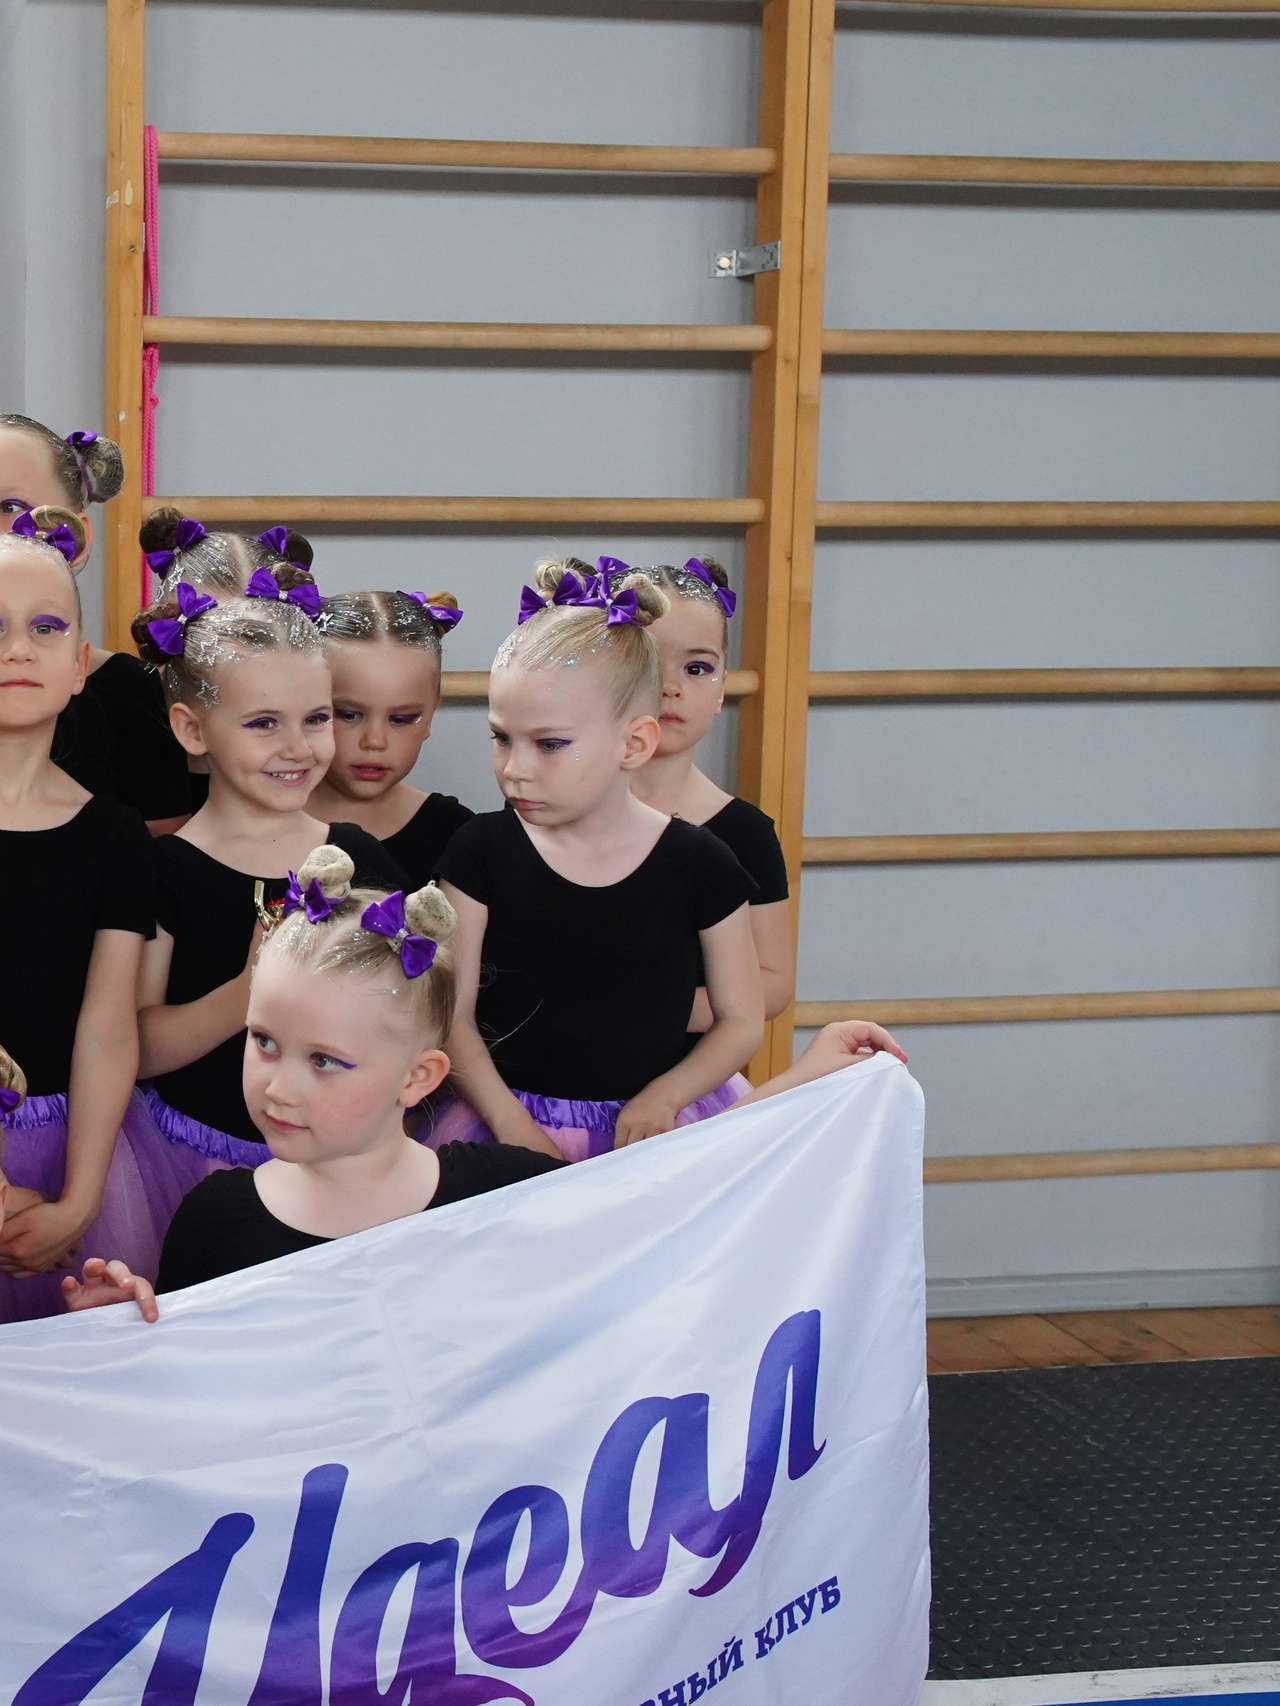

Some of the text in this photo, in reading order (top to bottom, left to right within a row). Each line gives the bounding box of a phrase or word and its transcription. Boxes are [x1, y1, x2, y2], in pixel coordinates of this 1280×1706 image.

[10, 1308, 828, 1706] Идеал
[638, 1575, 842, 1706] НЫЙ КЛУБ
